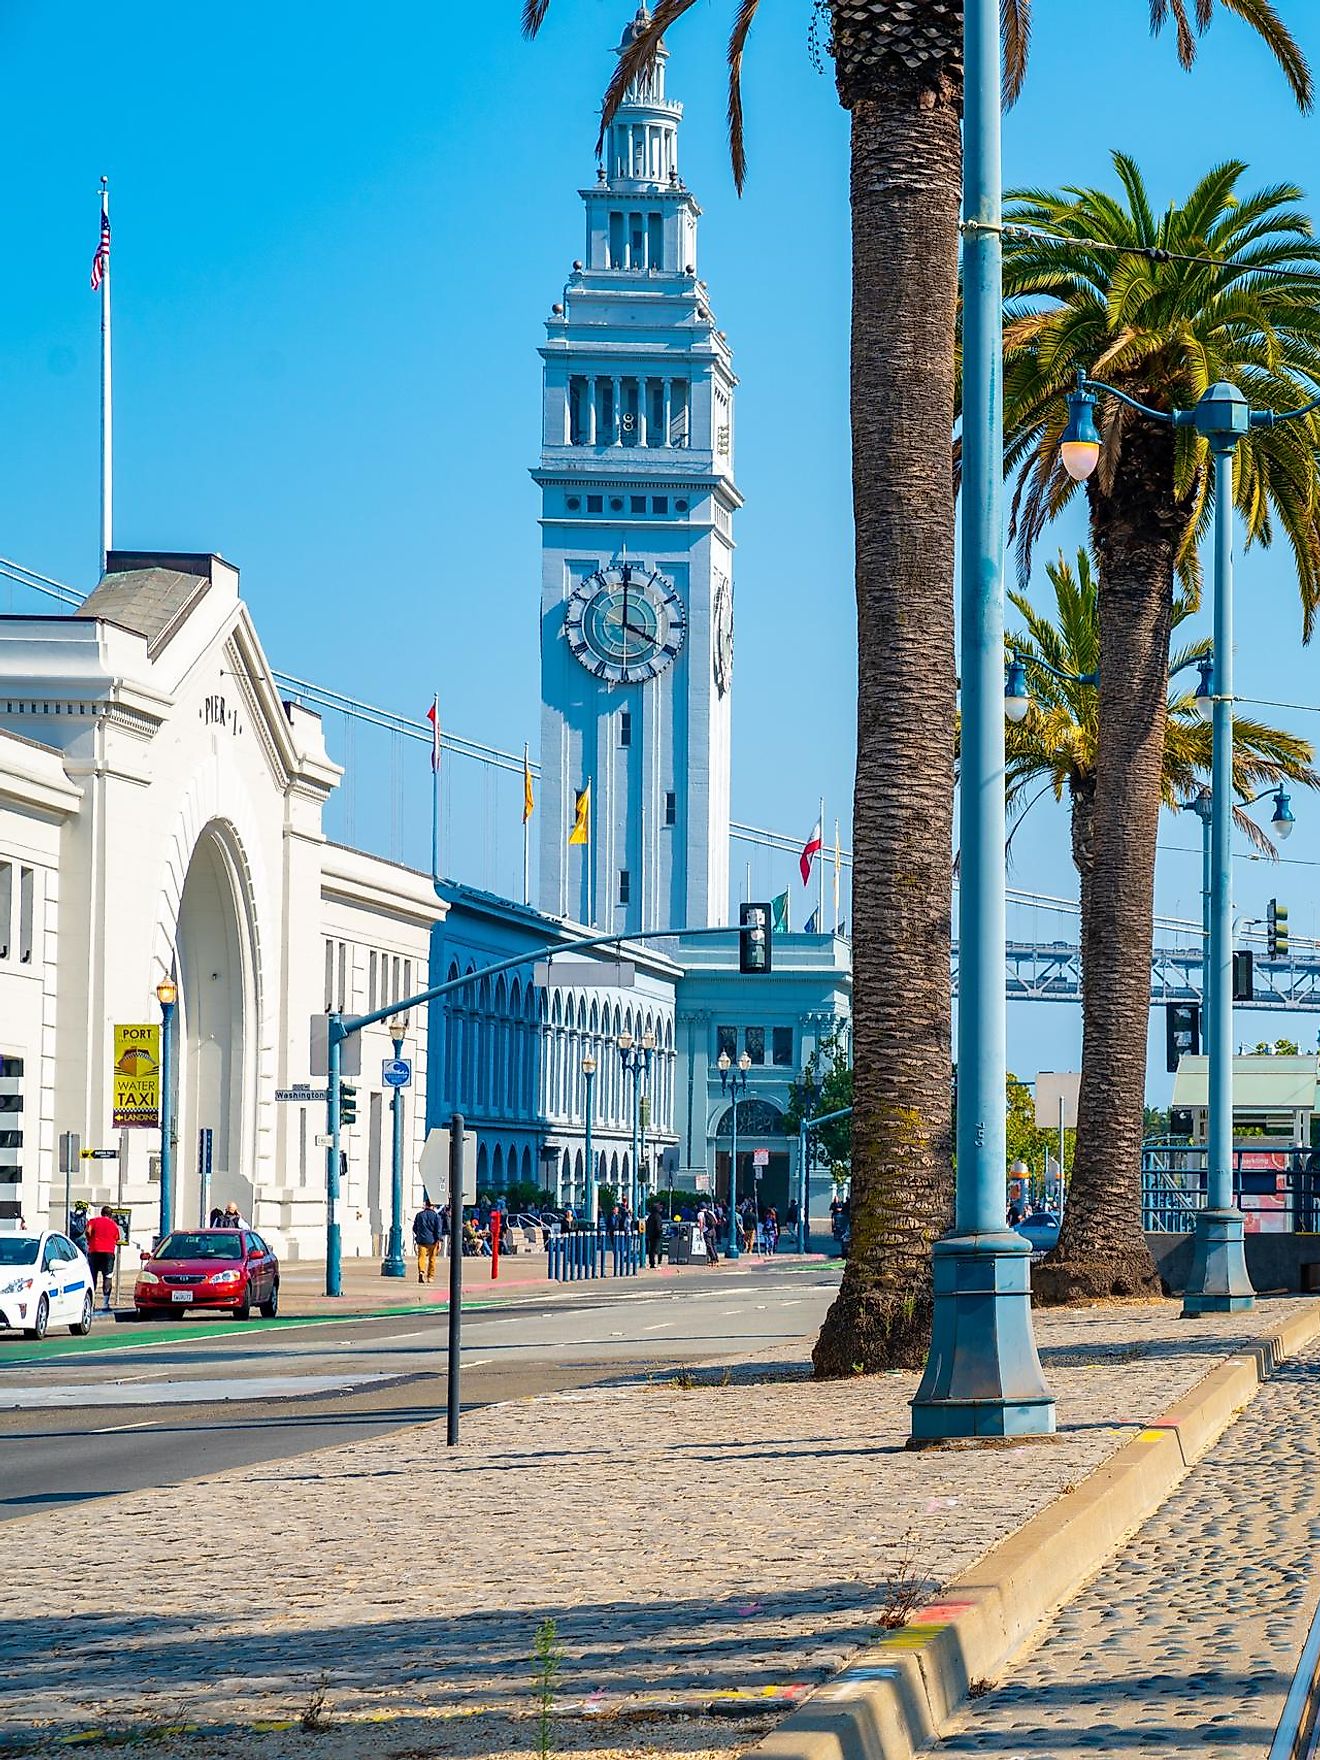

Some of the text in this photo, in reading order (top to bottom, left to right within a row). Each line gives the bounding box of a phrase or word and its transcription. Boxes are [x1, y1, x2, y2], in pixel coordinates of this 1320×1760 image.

[205, 695, 226, 727] PIER
[123, 1029, 152, 1039] PORT
[117, 1081, 155, 1091] WATER
[117, 1092, 154, 1106] TAXI
[276, 1091, 324, 1100] Washington
[124, 1113, 158, 1121] LANDING
